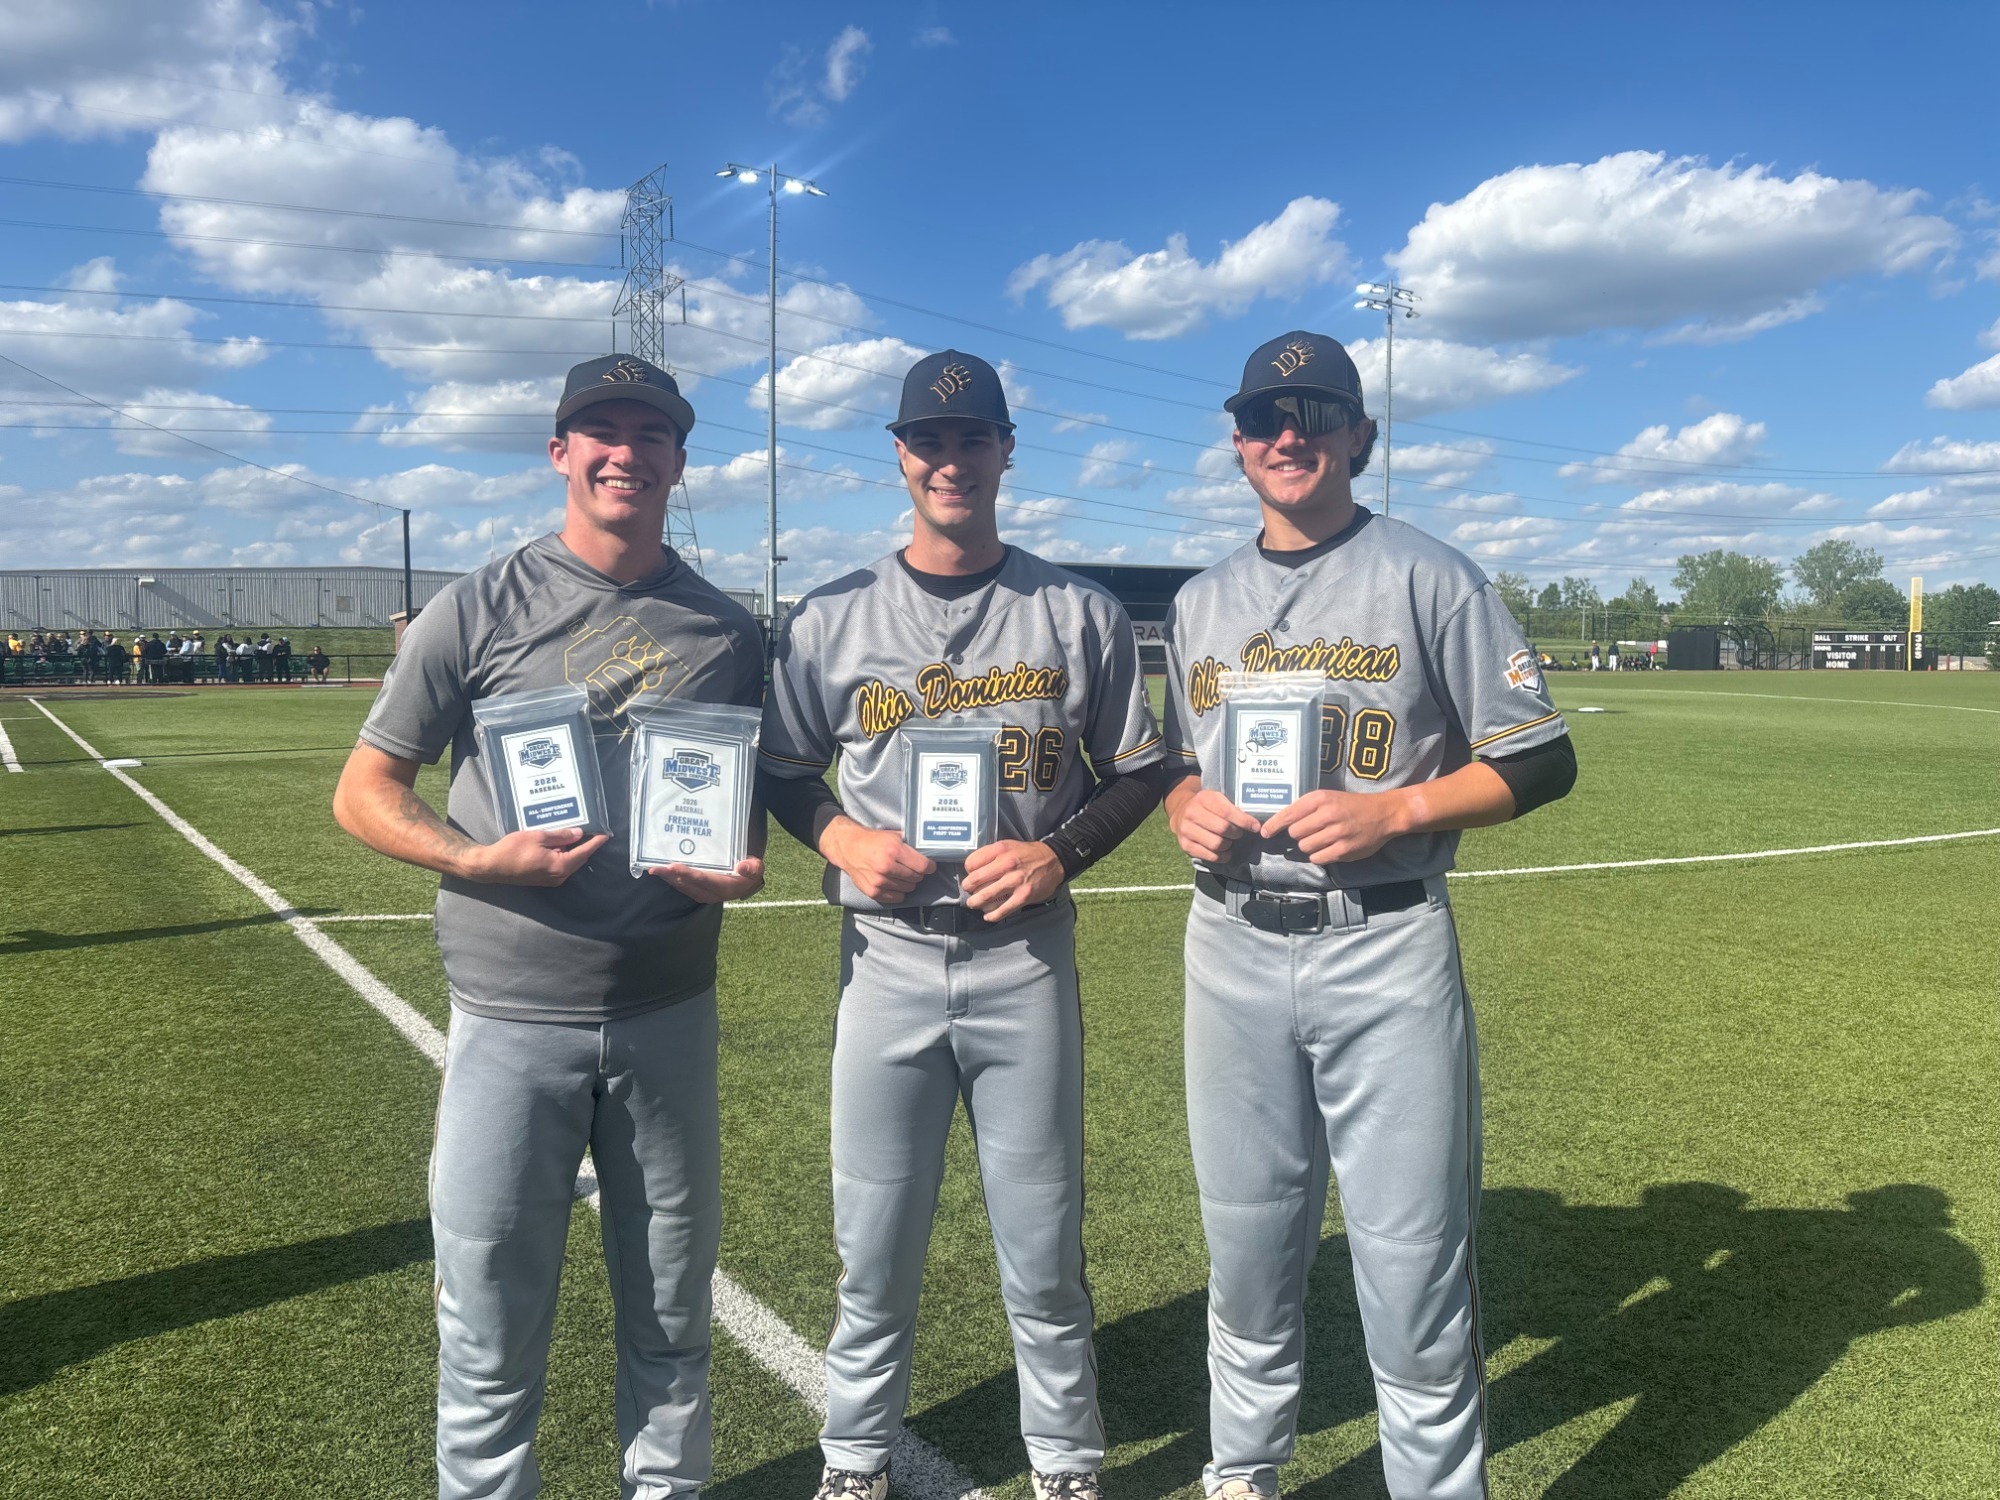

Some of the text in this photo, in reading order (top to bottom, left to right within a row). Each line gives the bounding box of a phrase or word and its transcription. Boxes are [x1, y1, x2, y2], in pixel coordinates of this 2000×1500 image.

[1133, 626, 1166, 640] RA
[1814, 634, 1898, 642] BALL STRIKE OUT
[1914, 634, 1922, 660] 325
[1241, 629, 1401, 684] Dominican
[1826, 652, 1857, 660] VISITOR
[1825, 661, 1850, 669] HOME
[856, 660, 1069, 741] Ohio Dominican
[520, 745, 560, 761] MIDWEST
[529, 744, 548, 752] GREAT
[679, 757, 706, 767] GREAT
[994, 726, 1066, 792] 26
[665, 760, 719, 778] MIDWEST
[534, 776, 557, 786] 2026
[529, 784, 565, 795] BASEBALL
[675, 805, 704, 815] BASEBALL
[668, 815, 709, 828] FRESHMAN
[664, 824, 712, 837] OF THE YEAR
